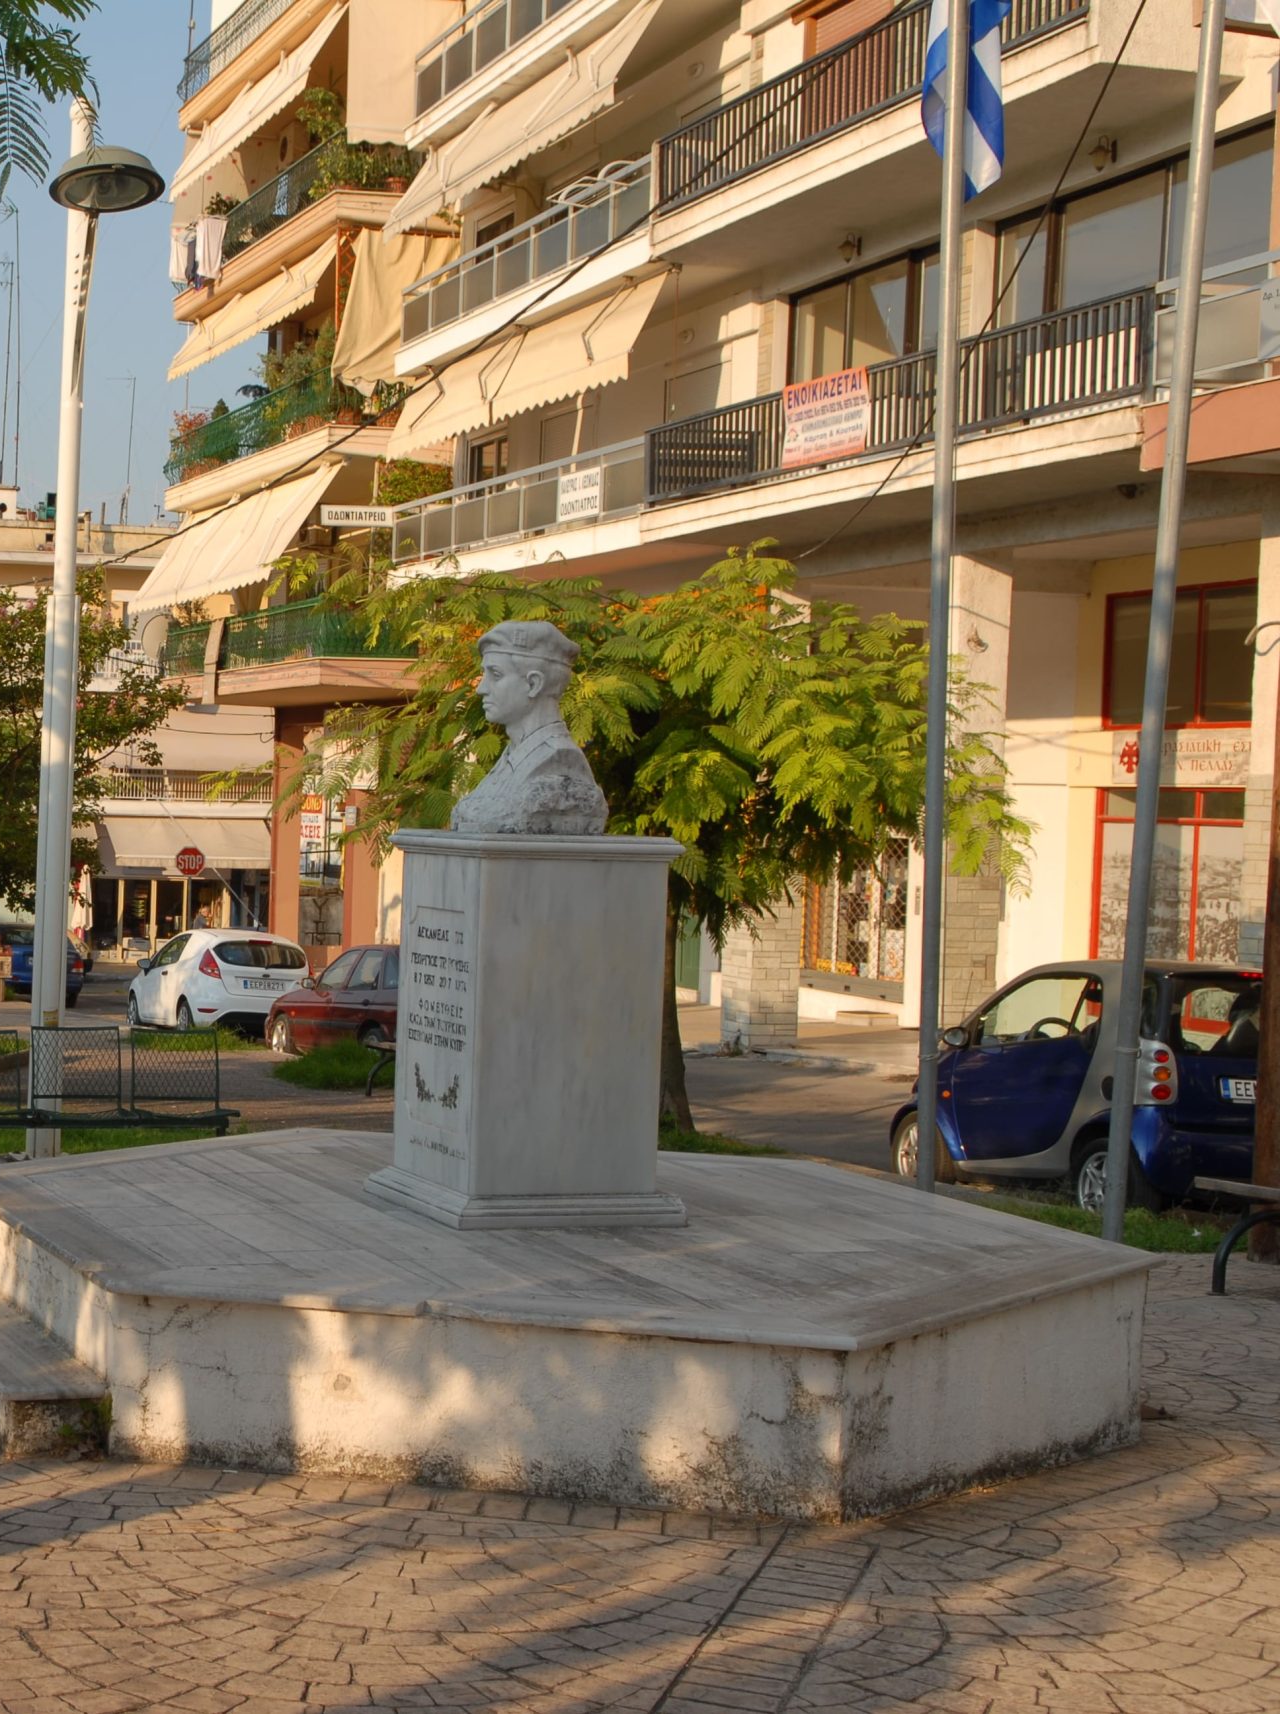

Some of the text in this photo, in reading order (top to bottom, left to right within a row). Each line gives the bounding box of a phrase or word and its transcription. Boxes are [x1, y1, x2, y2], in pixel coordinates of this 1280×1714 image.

[787, 371, 863, 410] ΕΝΟΙΚΙΑΖΕΤΑΙ
[327, 510, 386, 522] ΟΔΟΝΤΙΑΤΡΕΙΟ
[178, 855, 203, 870] STOP
